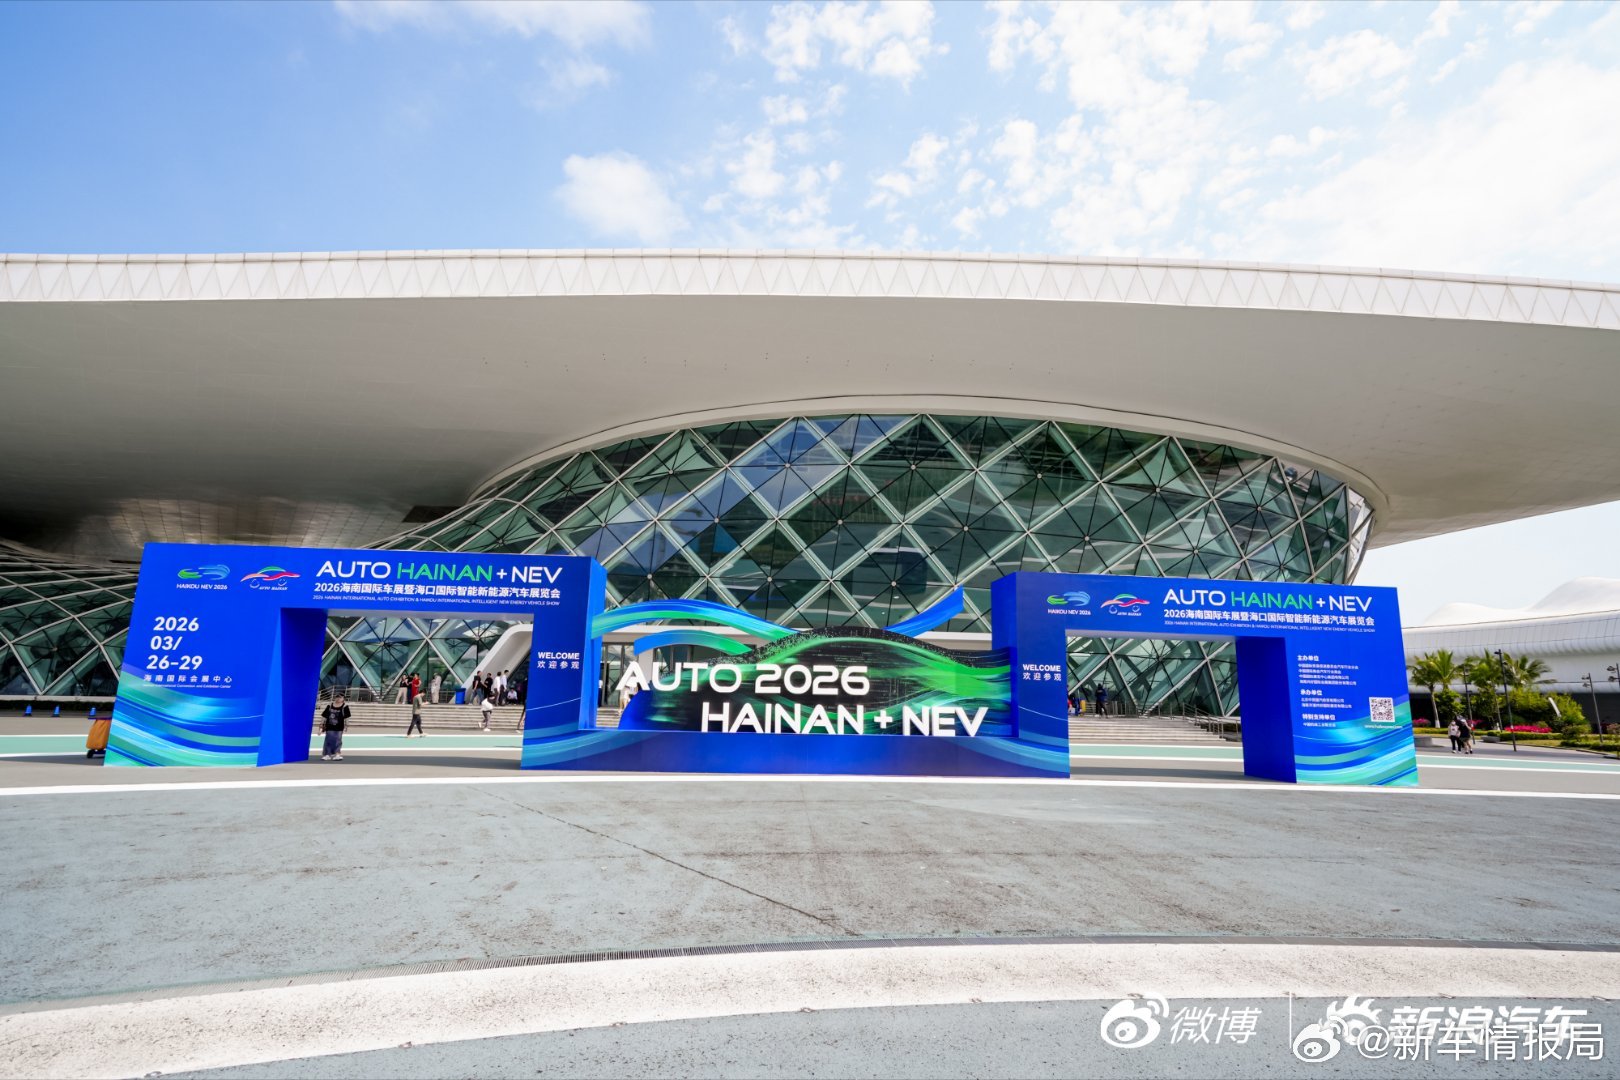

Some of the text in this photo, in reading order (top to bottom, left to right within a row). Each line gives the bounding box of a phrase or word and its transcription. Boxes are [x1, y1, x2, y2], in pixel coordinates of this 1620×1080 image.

[316, 561, 563, 584] AUTO HAINAN + NEV
[314, 582, 561, 599] 2026海南国际车展暨海口国际智能新能源汽车展览会
[1163, 588, 1373, 612] AUTO HAINAN + NEV
[153, 616, 200, 632] 2026
[1164, 609, 1375, 627] 2026海南国际车展暨海口国际智能新能源汽车展览会
[150, 636, 183, 650] 03/
[146, 654, 203, 670] 26-29
[538, 652, 580, 660] WELCOME
[537, 660, 580, 670] 欢迎参观
[1022, 664, 1062, 672] WELCOME
[144, 674, 232, 684] 海南国际会展中心
[615, 661, 871, 696] AUTO 2026
[1022, 672, 1062, 682] 欢迎参观
[701, 701, 989, 737] HAINAN + NEV
